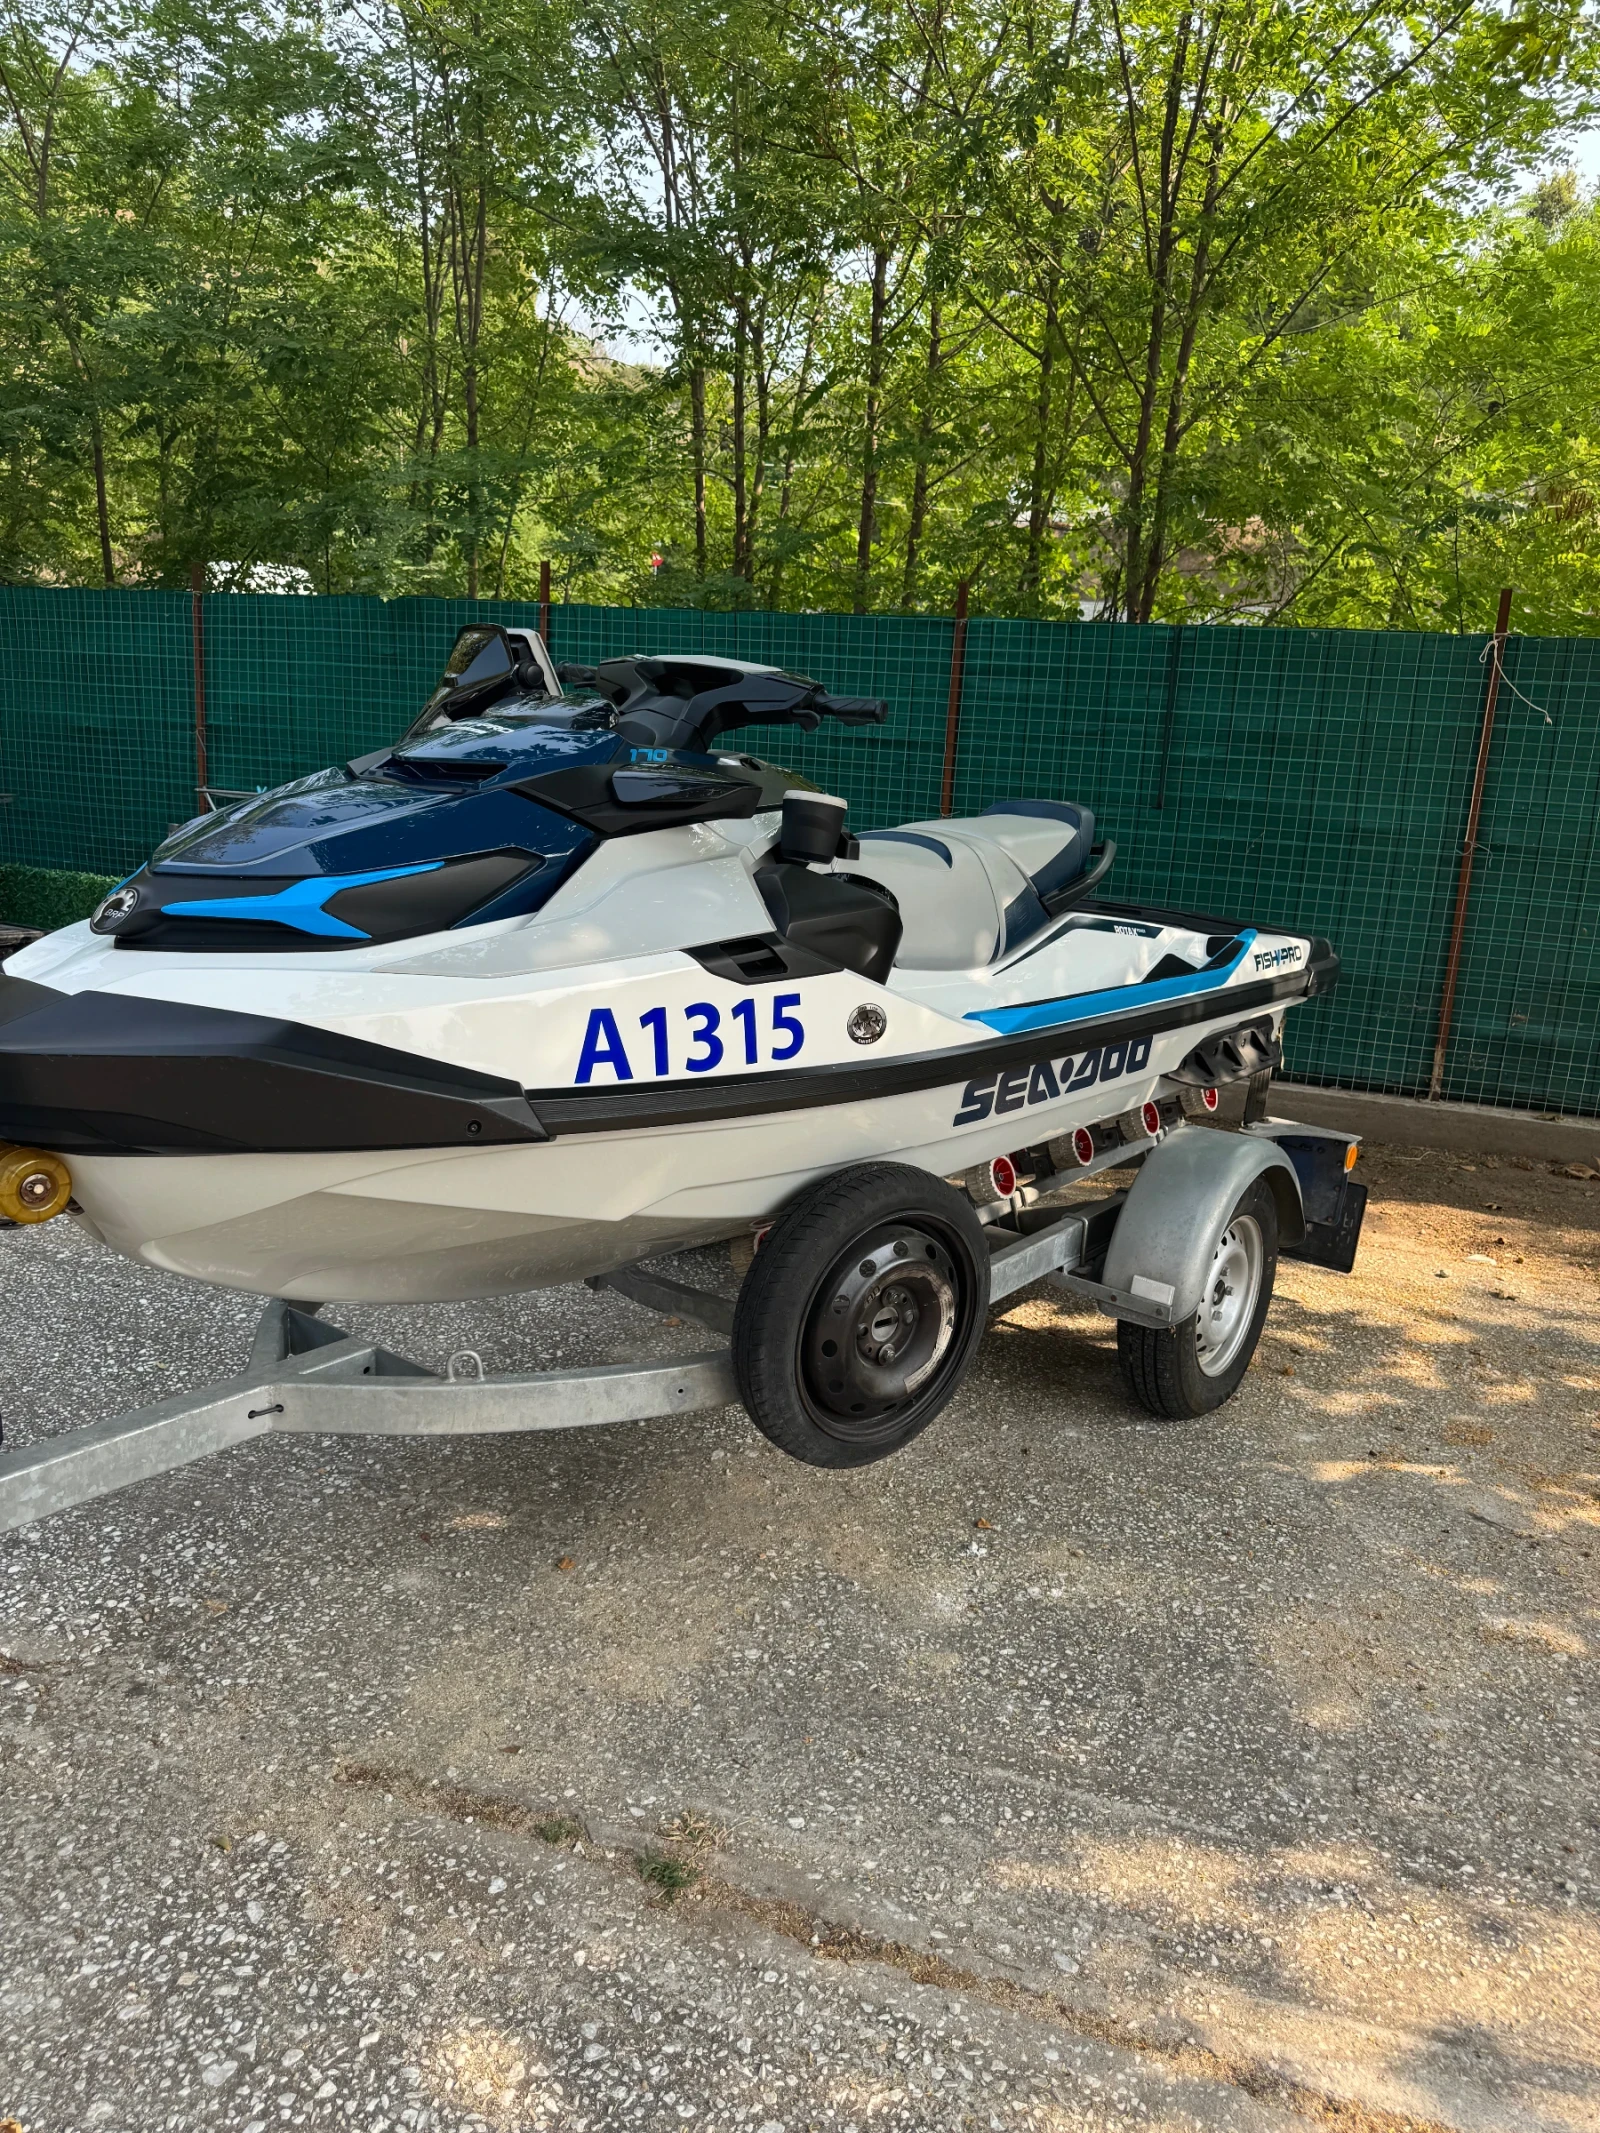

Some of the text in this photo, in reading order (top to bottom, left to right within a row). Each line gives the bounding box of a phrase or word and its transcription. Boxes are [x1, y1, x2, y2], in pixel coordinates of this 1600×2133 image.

[630, 748, 668, 762] 170
[104, 908, 125, 919] BRP
[574, 993, 805, 1084] A1315
